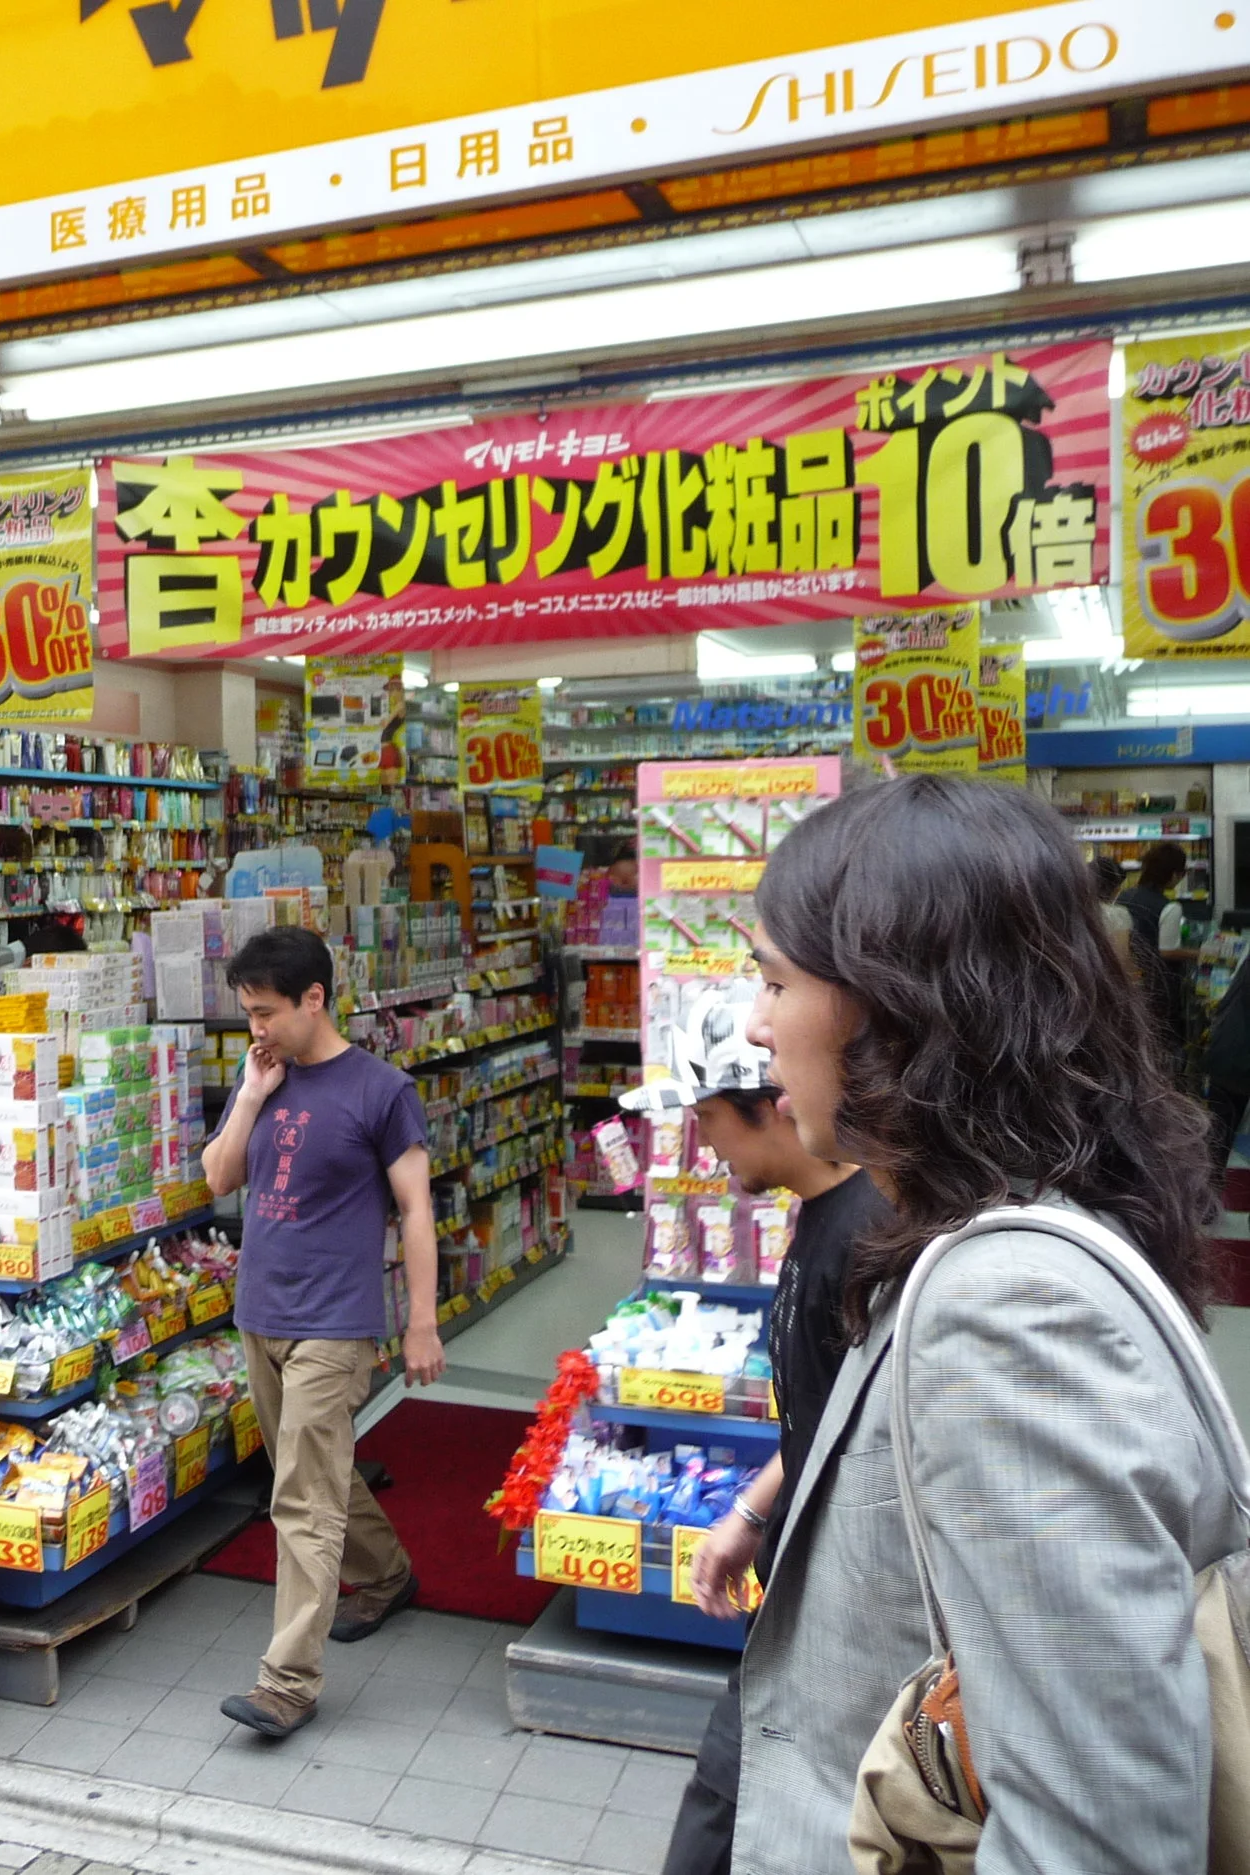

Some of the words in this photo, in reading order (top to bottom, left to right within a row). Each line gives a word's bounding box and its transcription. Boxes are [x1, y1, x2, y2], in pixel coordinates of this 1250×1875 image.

[711, 22, 1120, 135] SHISEIDO
[49, 172, 272, 254] 医療用品
[388, 116, 575, 192] 日用品
[855, 352, 1030, 431] ポイント
[463, 428, 631, 472] マツモトキヨシ
[255, 426, 855, 610] カウンセリング化粧品
[855, 411, 1024, 598] 10
[1007, 490, 1096, 588] 倍
[49, 633, 91, 675] OFF
[865, 673, 974, 749] 30%
[942, 709, 977, 738] OFF
[467, 731, 540, 786] 30%
[996, 735, 1024, 758] OFF
[70, 1360, 93, 1379] 158
[655, 1386, 725, 1412] 698
[141, 1484, 167, 1517] 98
[79, 1520, 108, 1559] 138
[563, 1553, 638, 1590] 498
